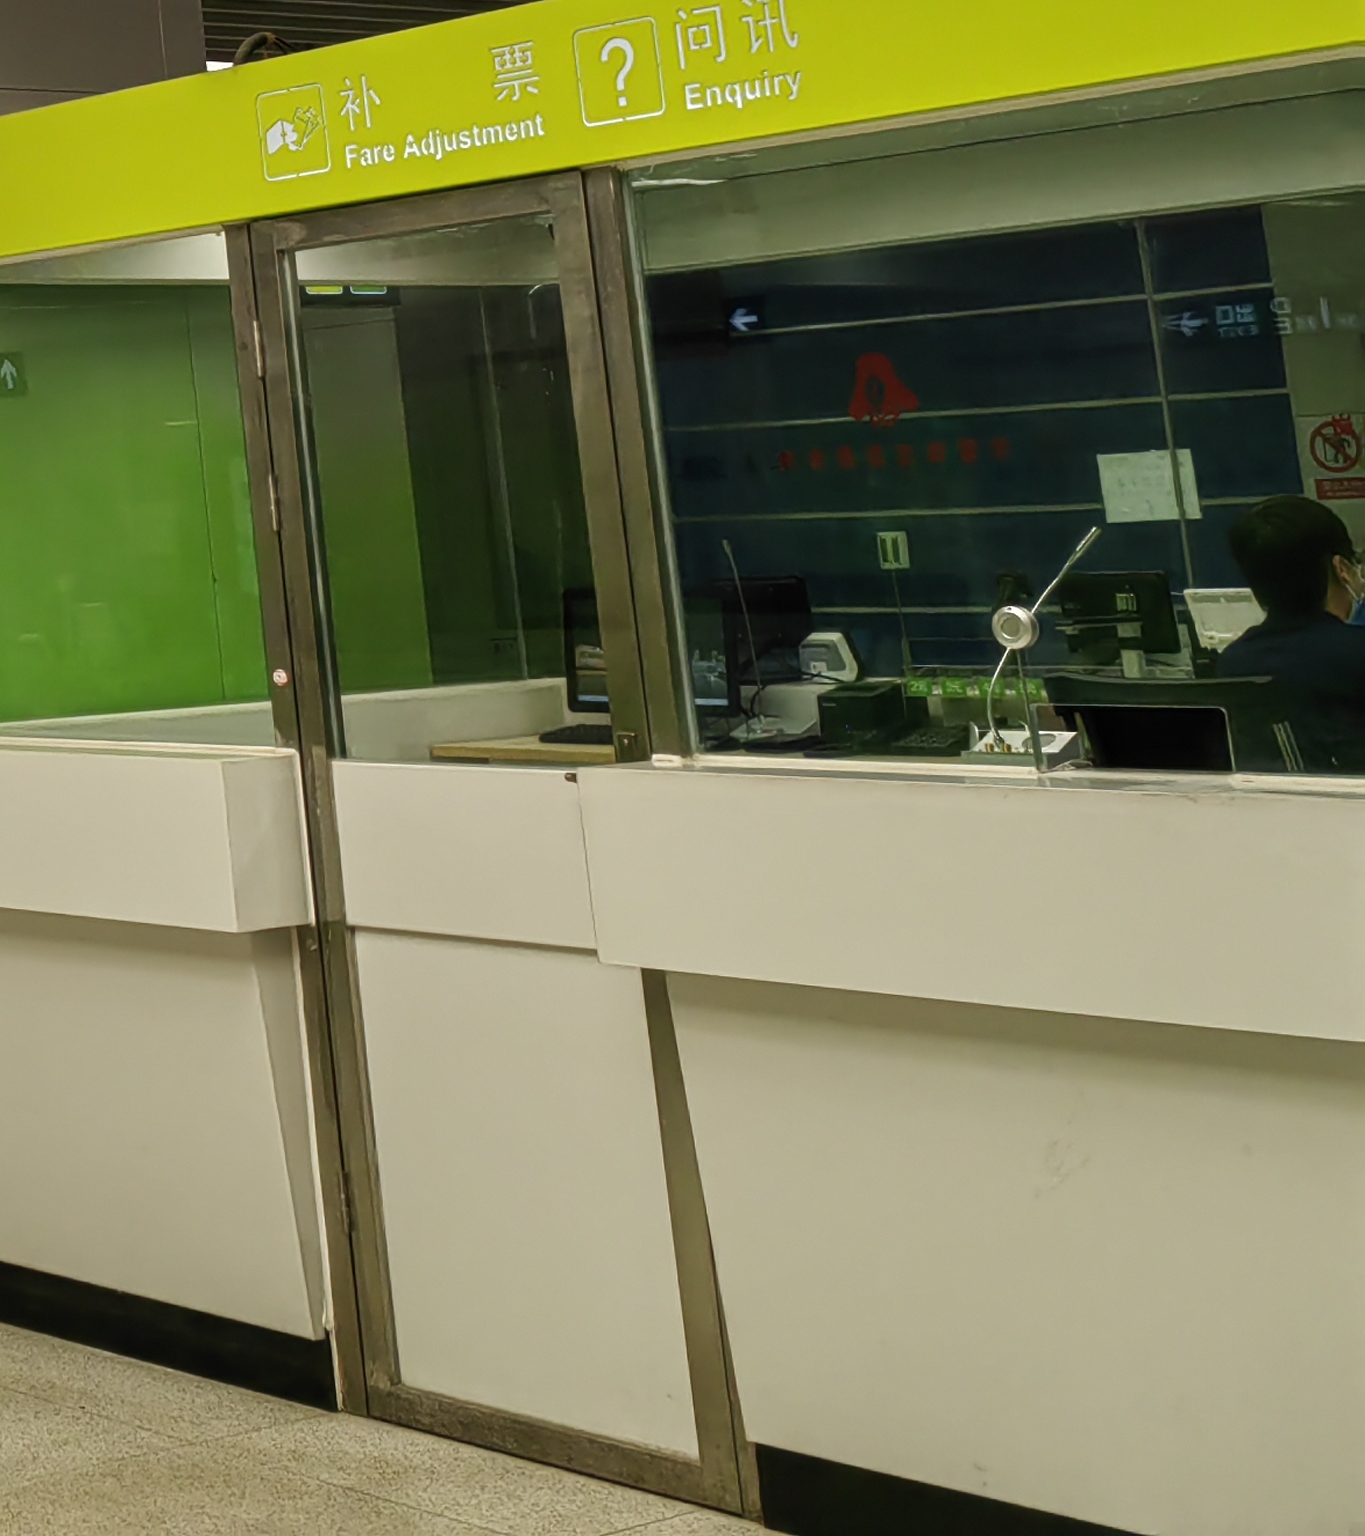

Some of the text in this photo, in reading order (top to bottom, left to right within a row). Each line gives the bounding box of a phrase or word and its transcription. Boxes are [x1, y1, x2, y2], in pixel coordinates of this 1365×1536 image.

[339, 40, 540, 131] 补票
[684, 69, 802, 111] Enquiry
[345, 113, 545, 168] Fare Adjustment
